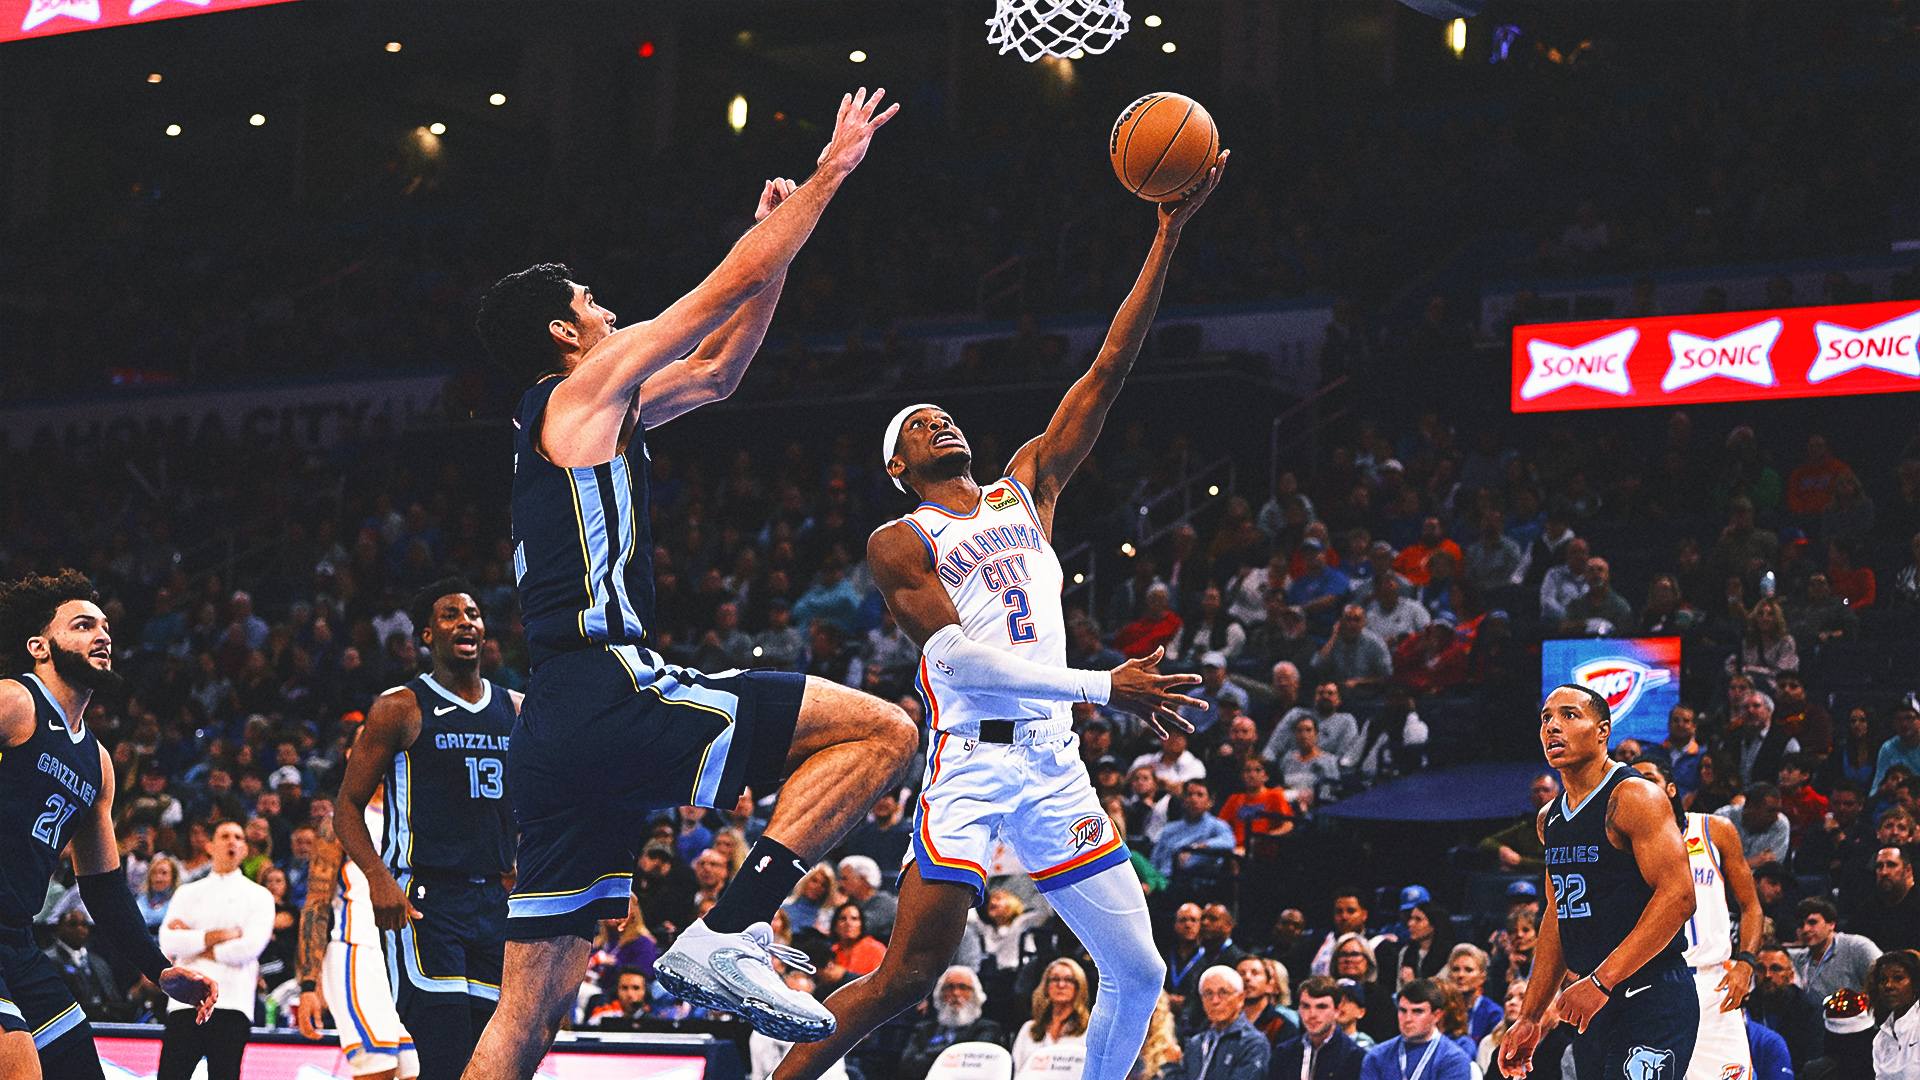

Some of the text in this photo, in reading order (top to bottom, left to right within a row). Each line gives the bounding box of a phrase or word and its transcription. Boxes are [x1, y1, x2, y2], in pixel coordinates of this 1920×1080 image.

[1538, 353, 1619, 378] SONIC
[1679, 345, 1762, 370] SONIC
[1825, 335, 1912, 361] SONIC
[937, 523, 1043, 588] OKLAHOMA
[981, 554, 1031, 592] CITY
[1002, 586, 1038, 645] 2
[434, 733, 511, 751] GRIZZLIE
[37, 752, 97, 807] GRIZZLIES
[465, 757, 504, 799] 13
[31, 793, 77, 849] 21
[1551, 873, 1592, 919] 22
